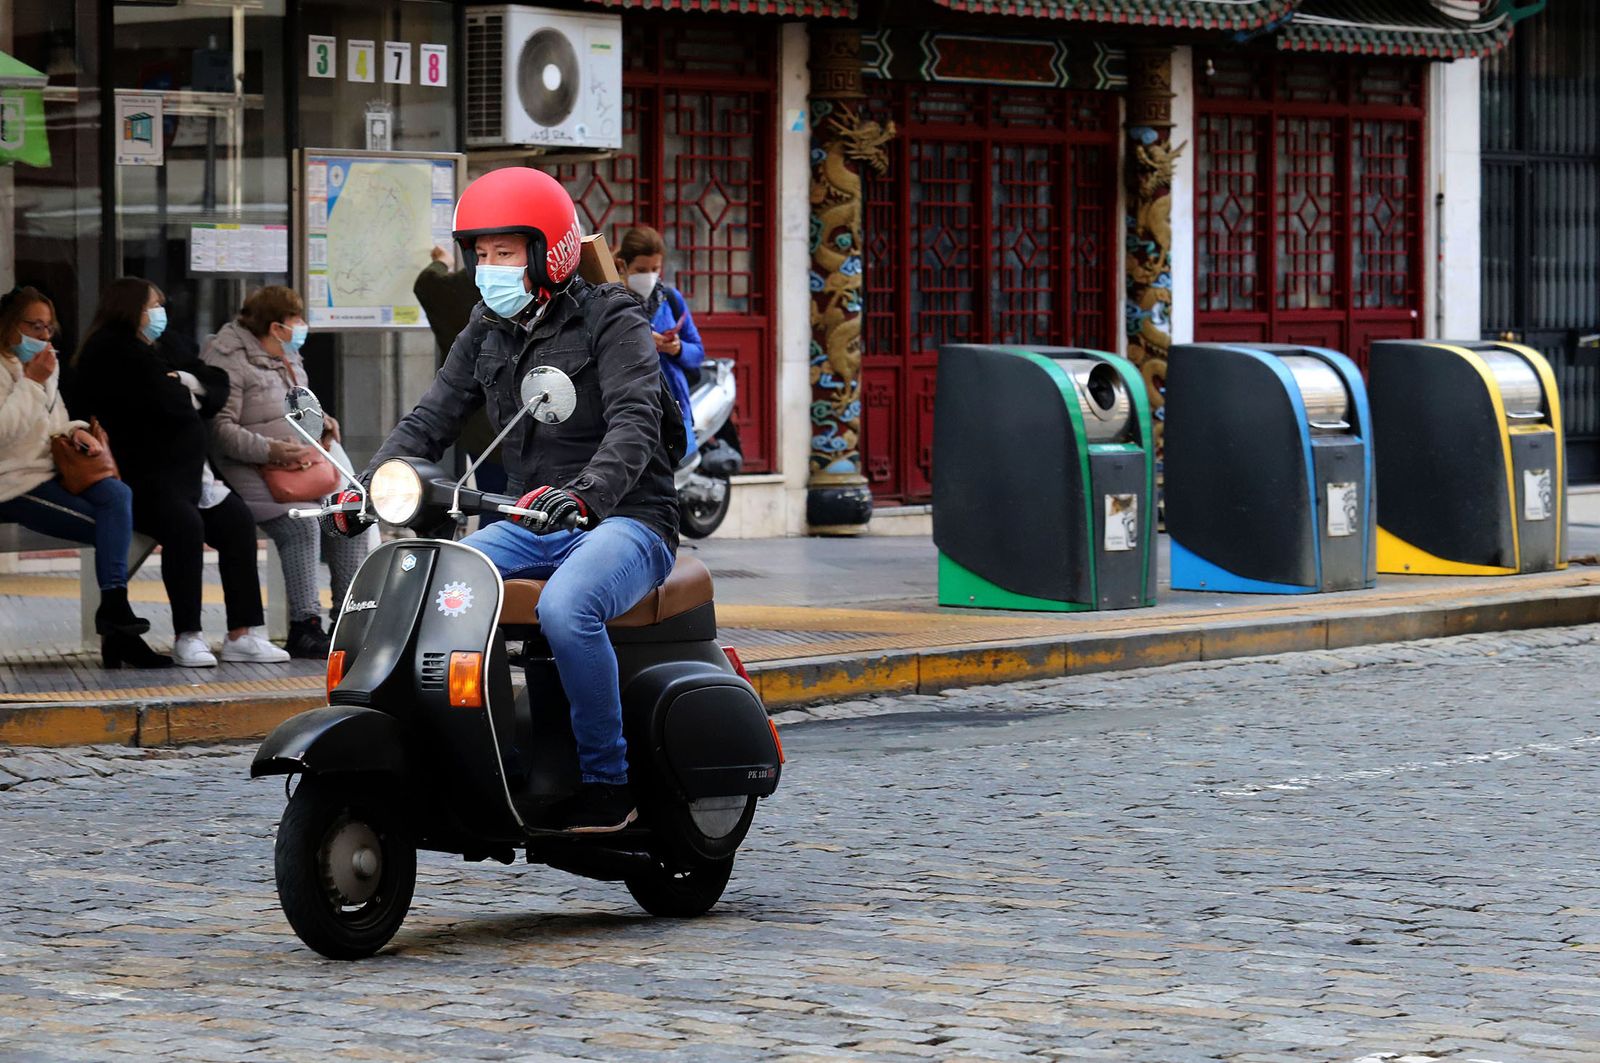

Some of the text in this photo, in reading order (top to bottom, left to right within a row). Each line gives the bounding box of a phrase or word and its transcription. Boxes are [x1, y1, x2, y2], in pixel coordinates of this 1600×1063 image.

[316, 44, 329, 75] 3
[355, 49, 368, 80] 4
[393, 51, 403, 80] 7
[428, 53, 440, 83] 8
[345, 593, 378, 613] Vespa
